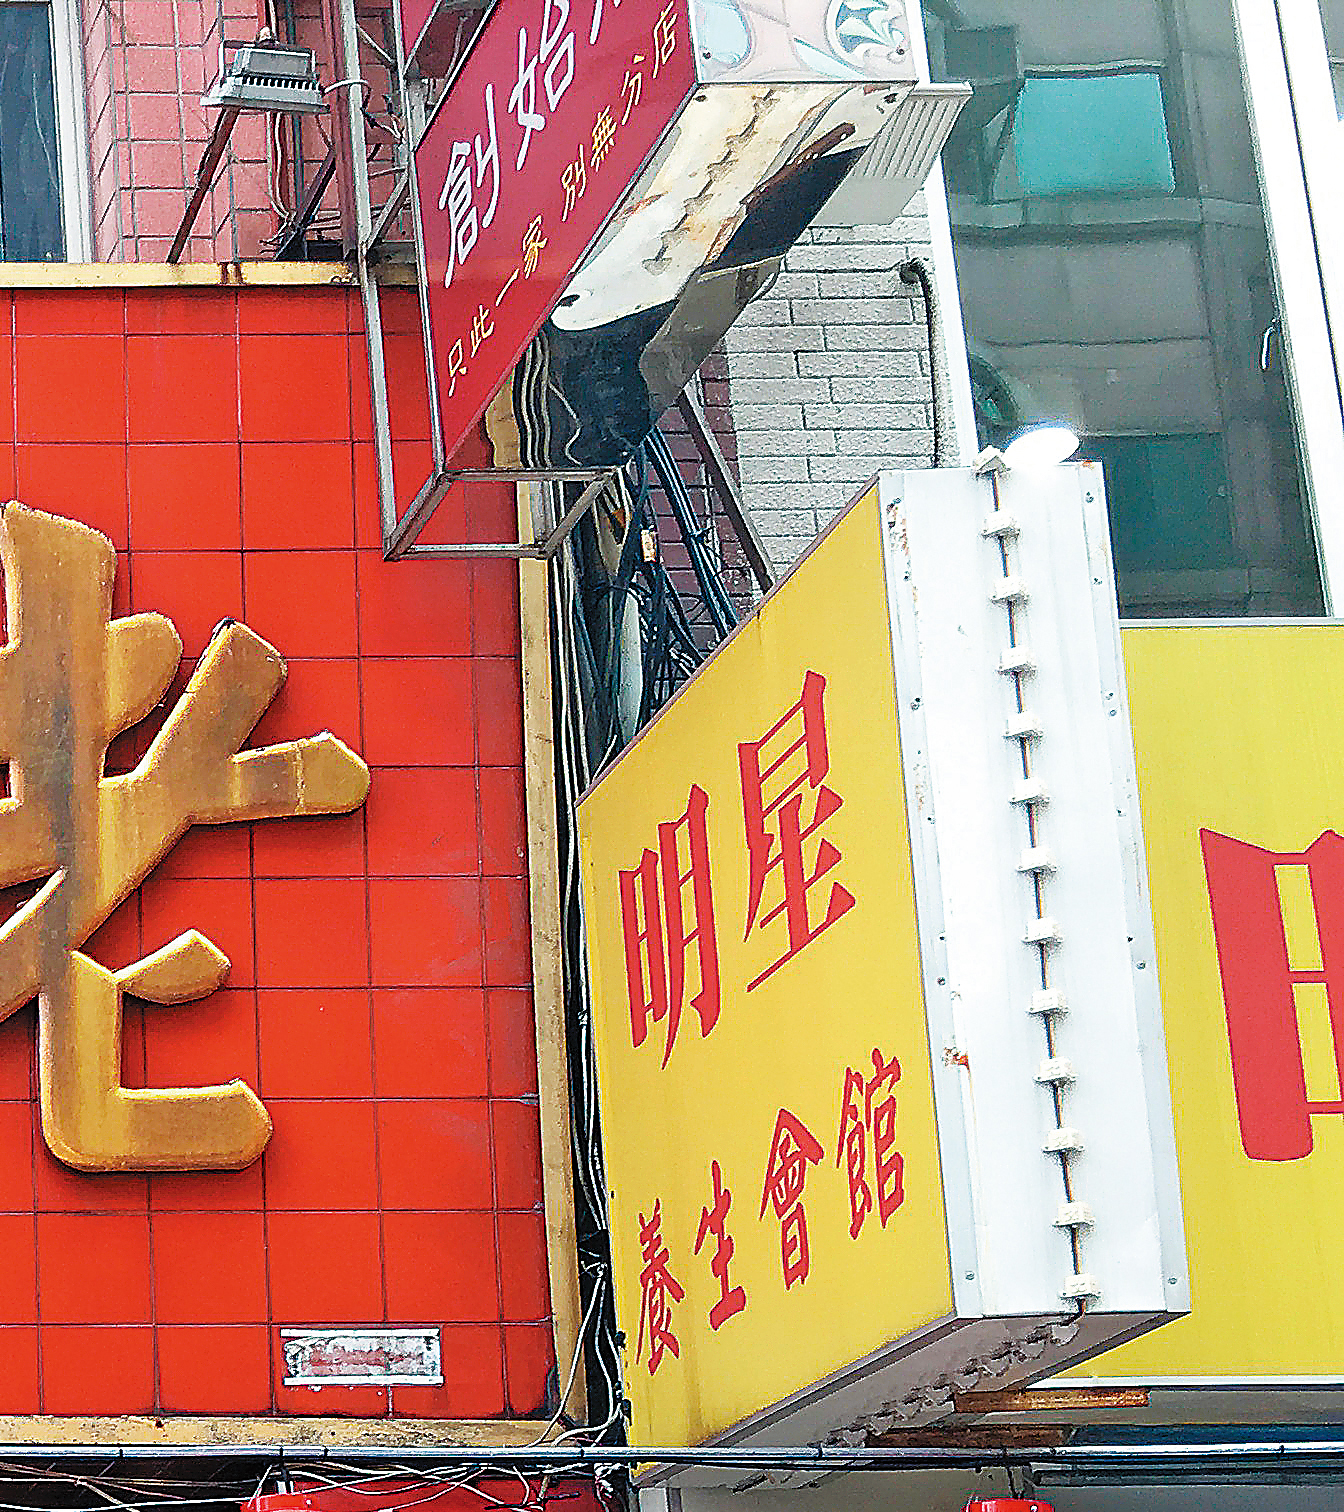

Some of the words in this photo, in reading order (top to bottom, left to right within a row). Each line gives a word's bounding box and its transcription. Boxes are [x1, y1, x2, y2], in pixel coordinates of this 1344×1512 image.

[618, 670, 859, 1062] 明星
[642, 1049, 908, 1372] 養生會館
